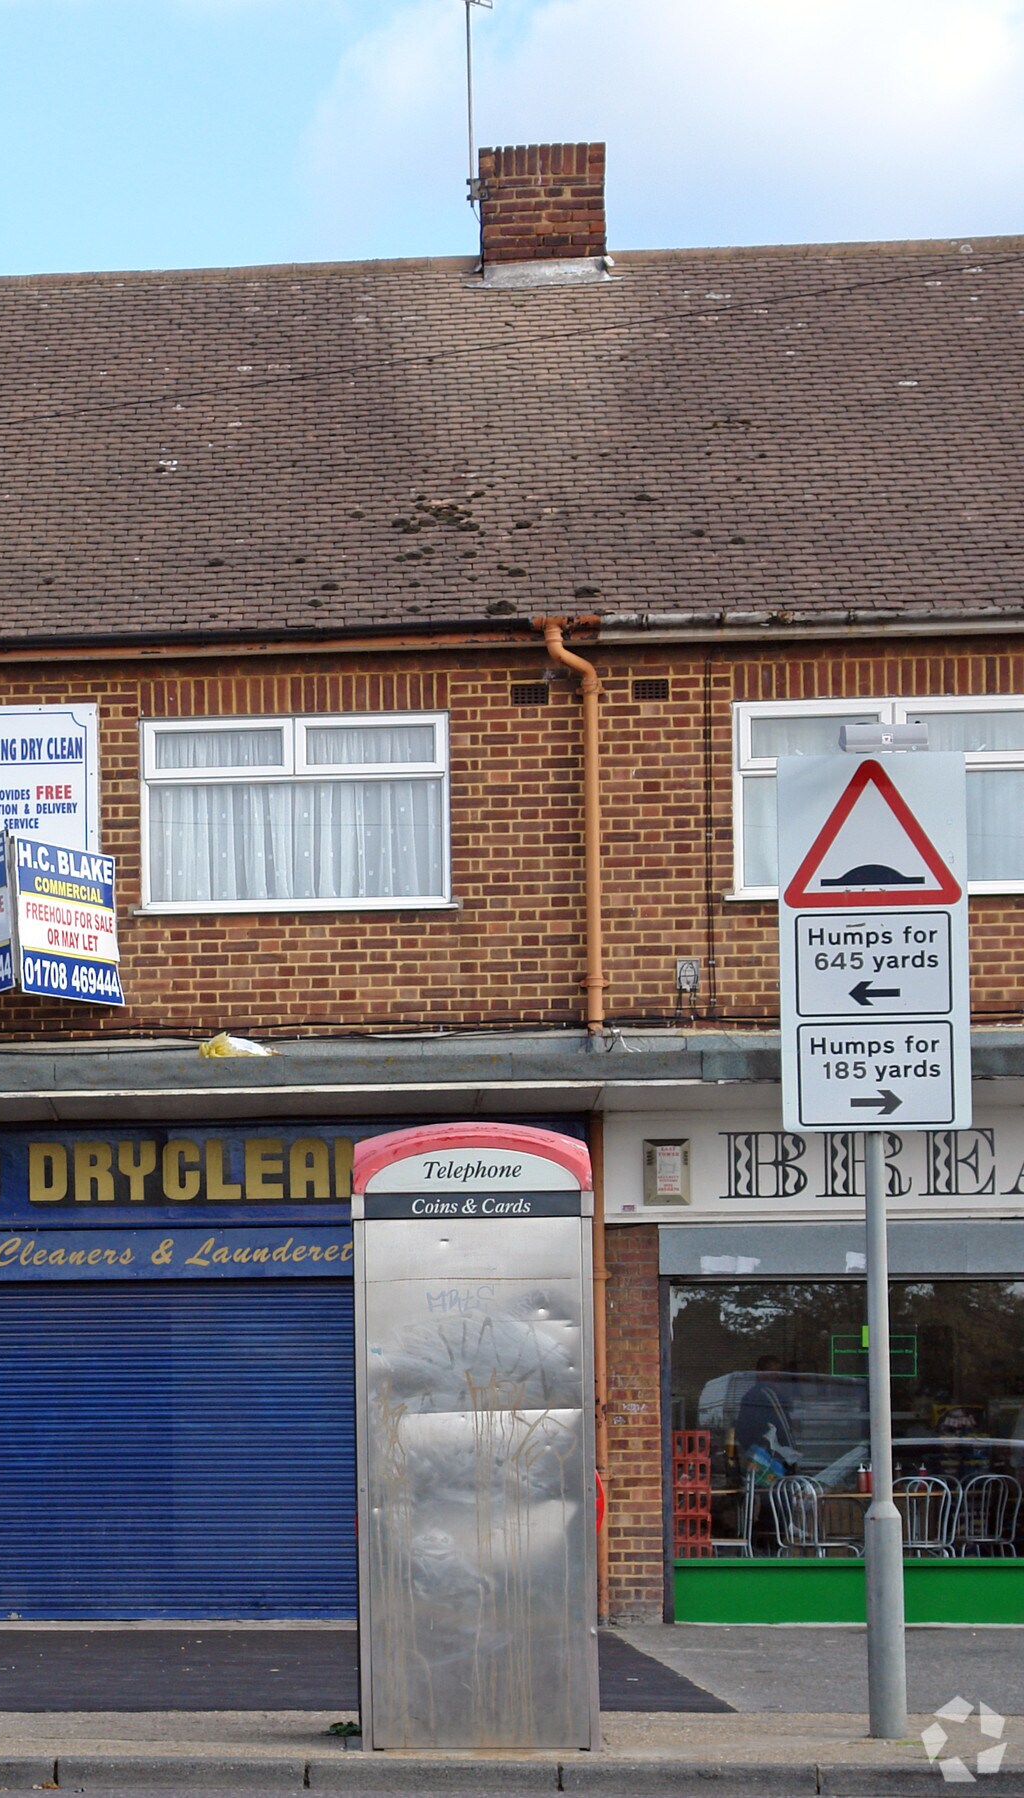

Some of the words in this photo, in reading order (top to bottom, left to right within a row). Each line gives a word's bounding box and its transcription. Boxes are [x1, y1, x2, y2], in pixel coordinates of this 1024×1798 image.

[21, 737, 43, 760] DRY
[47, 737, 83, 760] CLEAN
[36, 785, 72, 800] FREE
[24, 803, 30, 814] &
[36, 802, 78, 814] DELIVERY
[4, 818, 39, 829] SERVICE
[18, 842, 56, 873] H.C.
[57, 850, 113, 885] BLAKE
[34, 876, 103, 904] COMMERCIAL
[26, 902, 72, 926] FREEHOLD
[75, 911, 92, 929] FOR
[95, 914, 113, 934] SALE
[47, 928, 60, 946] OR
[62, 931, 80, 949] MAY
[82, 934, 98, 952] LET
[808, 927, 893, 947] Humps
[903, 926, 938, 944] for
[814, 952, 864, 971] 645
[873, 950, 939, 972] yards
[24, 957, 68, 990] 01708
[71, 964, 120, 998] 469444
[810, 1037, 895, 1057] Humps
[905, 1035, 940, 1053] for
[823, 1061, 867, 1079] 185
[875, 1059, 941, 1082] yards
[423, 1160, 522, 1182] Telephone
[411, 1199, 458, 1214] Coins
[461, 1198, 477, 1214] &
[481, 1198, 531, 1214] Cards
[151, 1239, 173, 1265] &
